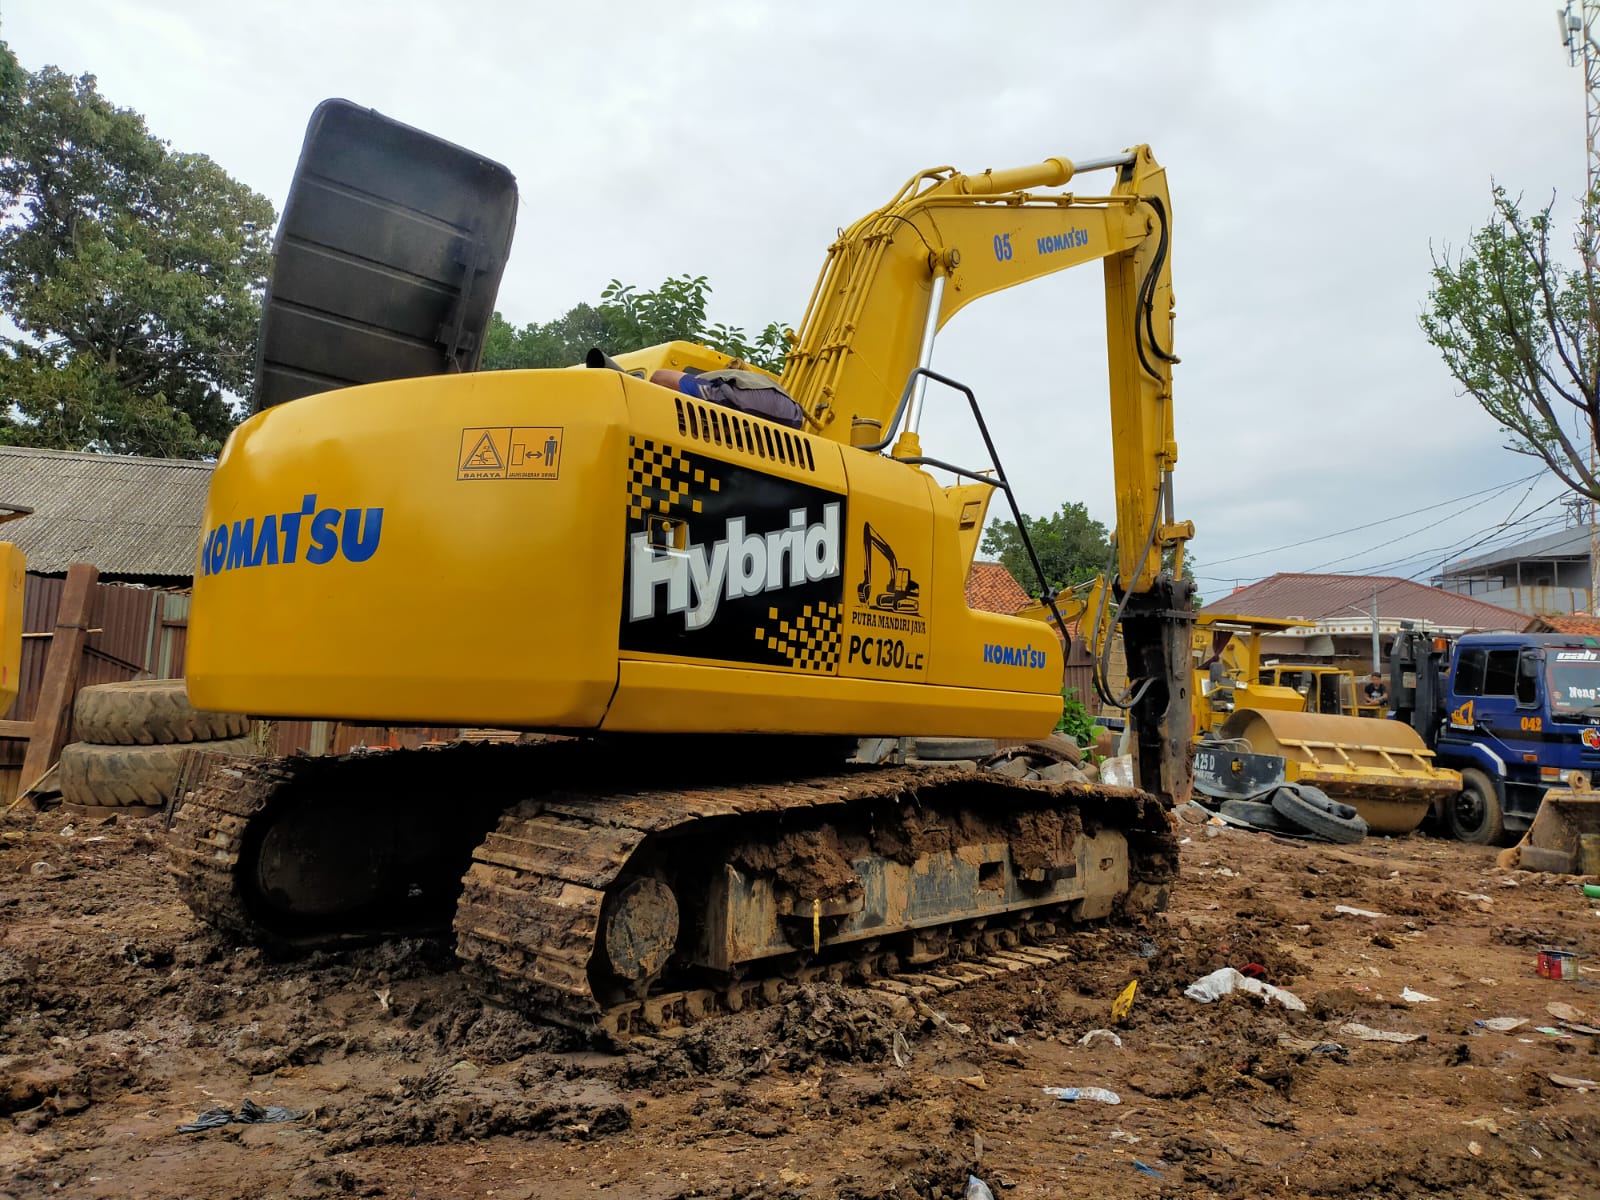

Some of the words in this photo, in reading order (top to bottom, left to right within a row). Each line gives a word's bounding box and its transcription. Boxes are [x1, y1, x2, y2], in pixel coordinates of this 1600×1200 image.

[993, 232, 1013, 262] 05
[1037, 226, 1089, 256] KOMATSU
[199, 494, 384, 578] KOMATSU
[629, 501, 841, 631] Hybrid
[852, 611, 877, 627] PUTRA
[878, 615, 910, 632] MANDIRI
[911, 620, 926, 636] JAYA
[983, 643, 1046, 669] KOMATSU
[1520, 716, 1542, 732] 042
